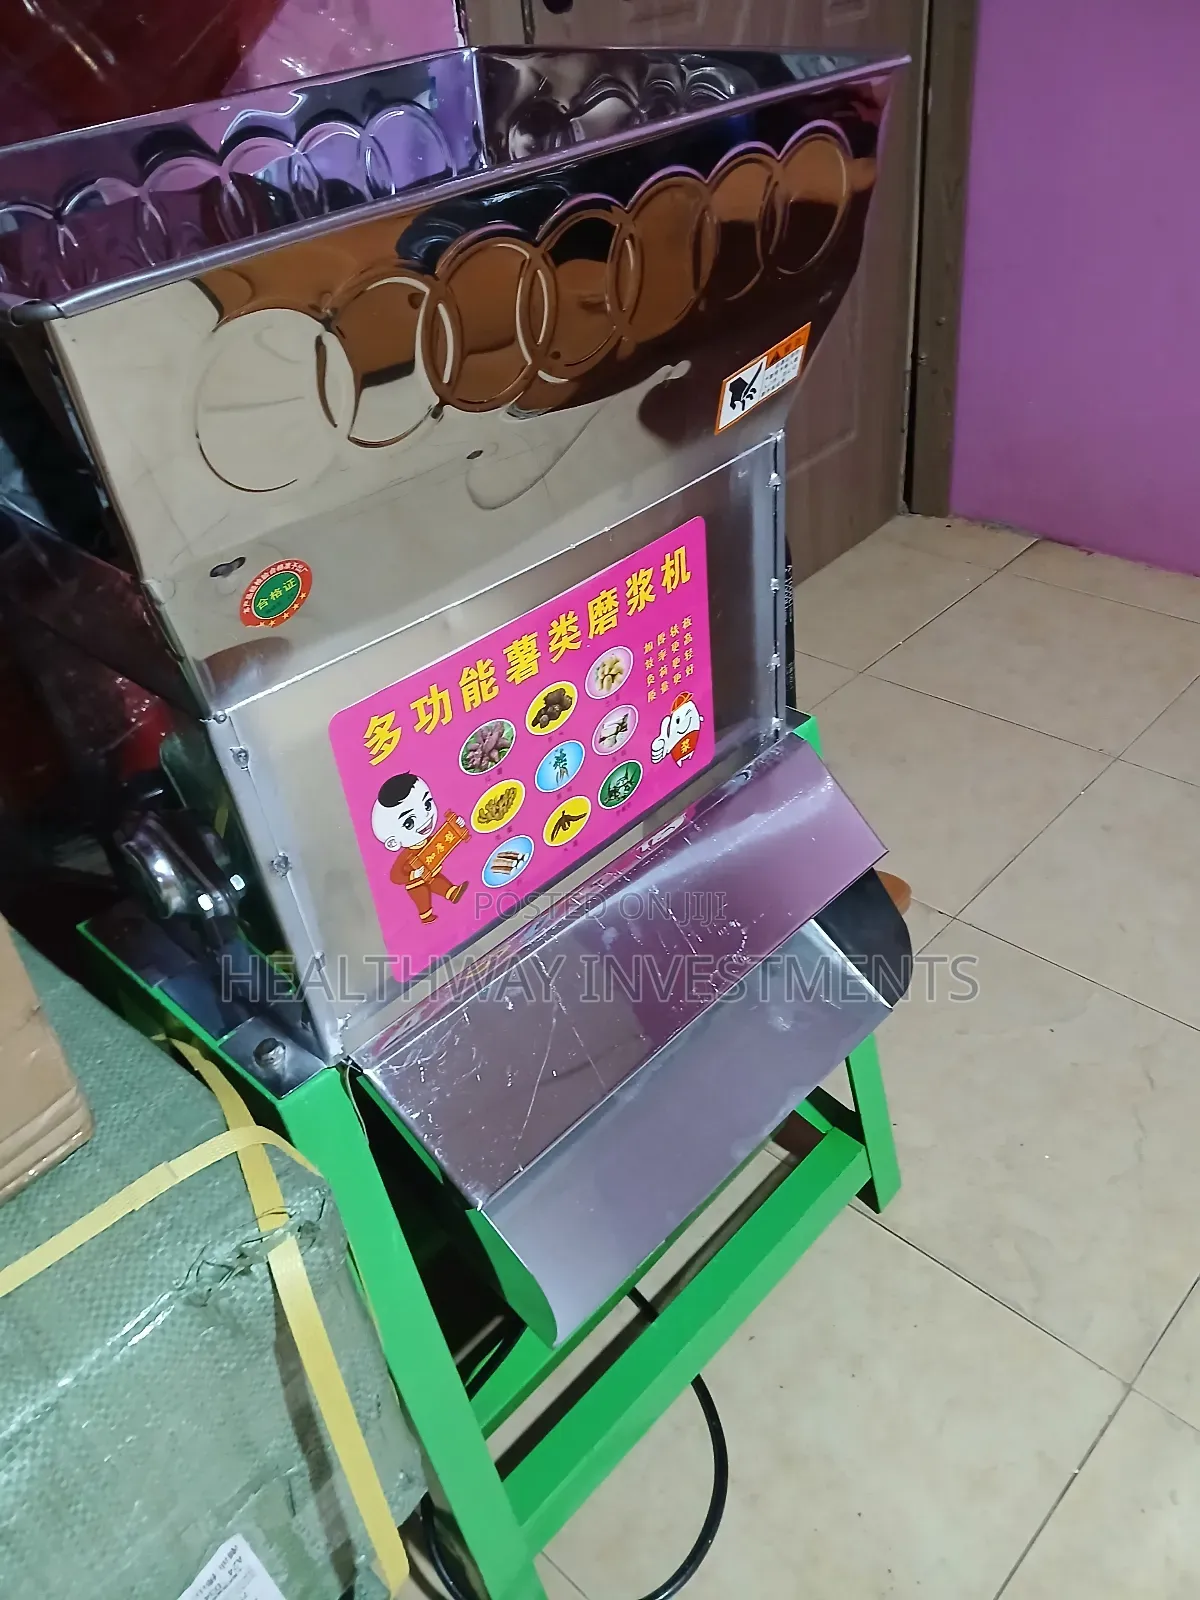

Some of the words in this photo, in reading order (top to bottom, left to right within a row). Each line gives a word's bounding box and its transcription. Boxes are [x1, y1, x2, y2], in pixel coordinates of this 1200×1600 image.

[256, 577, 297, 610] 合格证
[364, 546, 692, 766] 多功能薯类磨浆机
